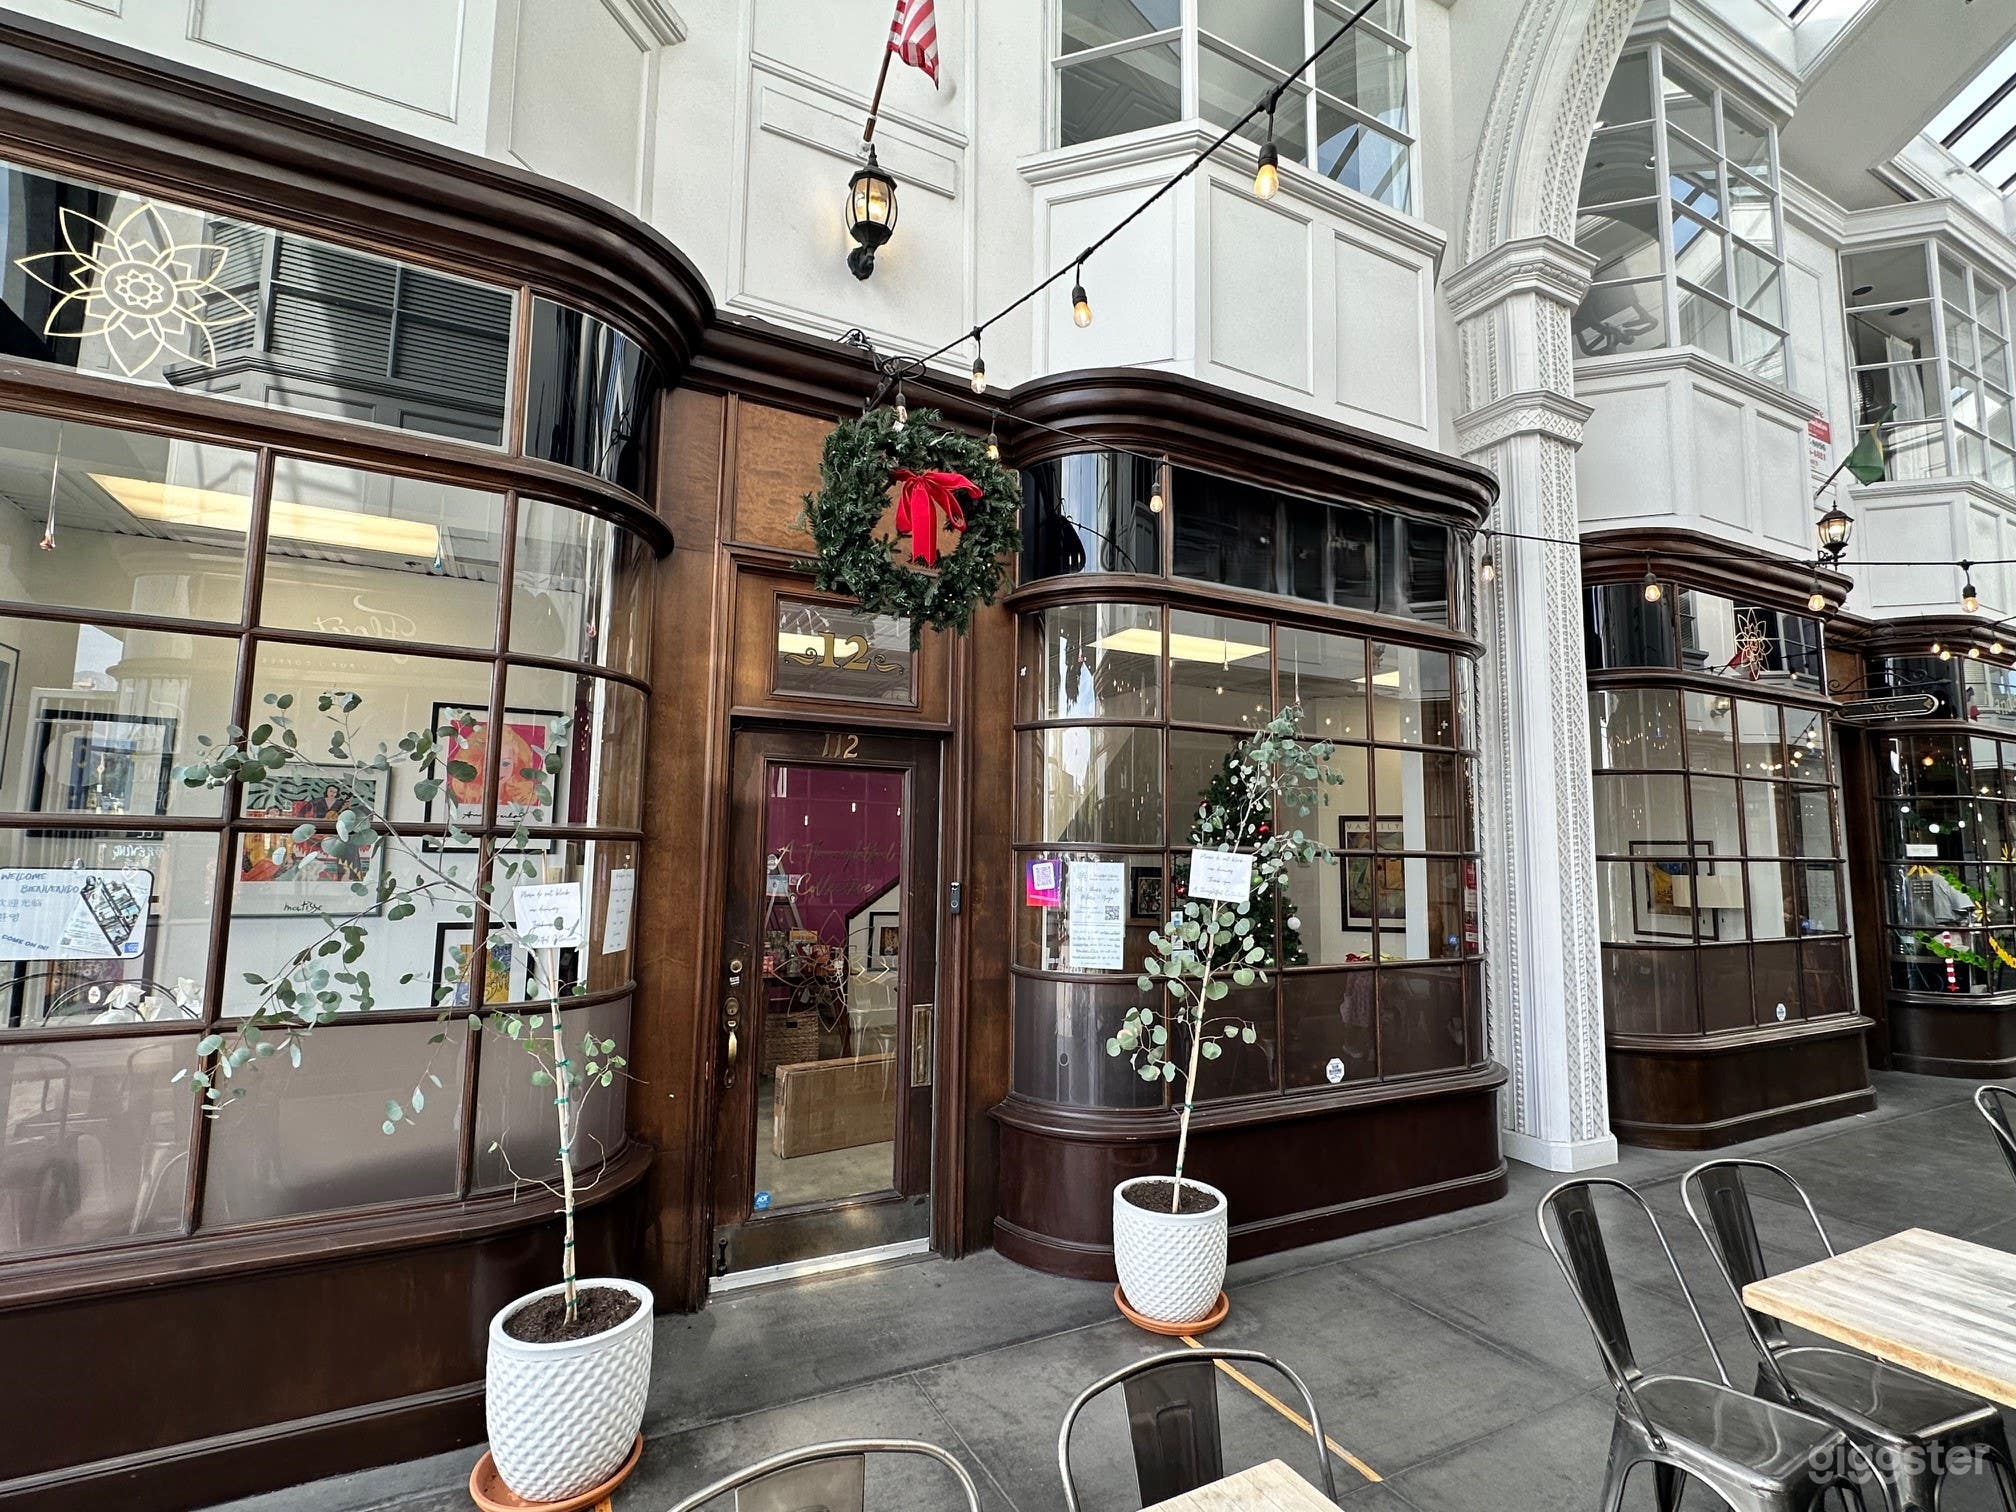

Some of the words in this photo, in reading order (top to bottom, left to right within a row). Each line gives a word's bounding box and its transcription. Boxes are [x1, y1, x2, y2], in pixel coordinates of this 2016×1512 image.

[817, 631, 872, 672] 12
[1872, 703, 1897, 712] W.C.
[822, 734, 859, 759] 112
[1, 872, 48, 881] WELCOME
[20, 884, 80, 894] BIENVENIDO
[2, 934, 24, 945] COME
